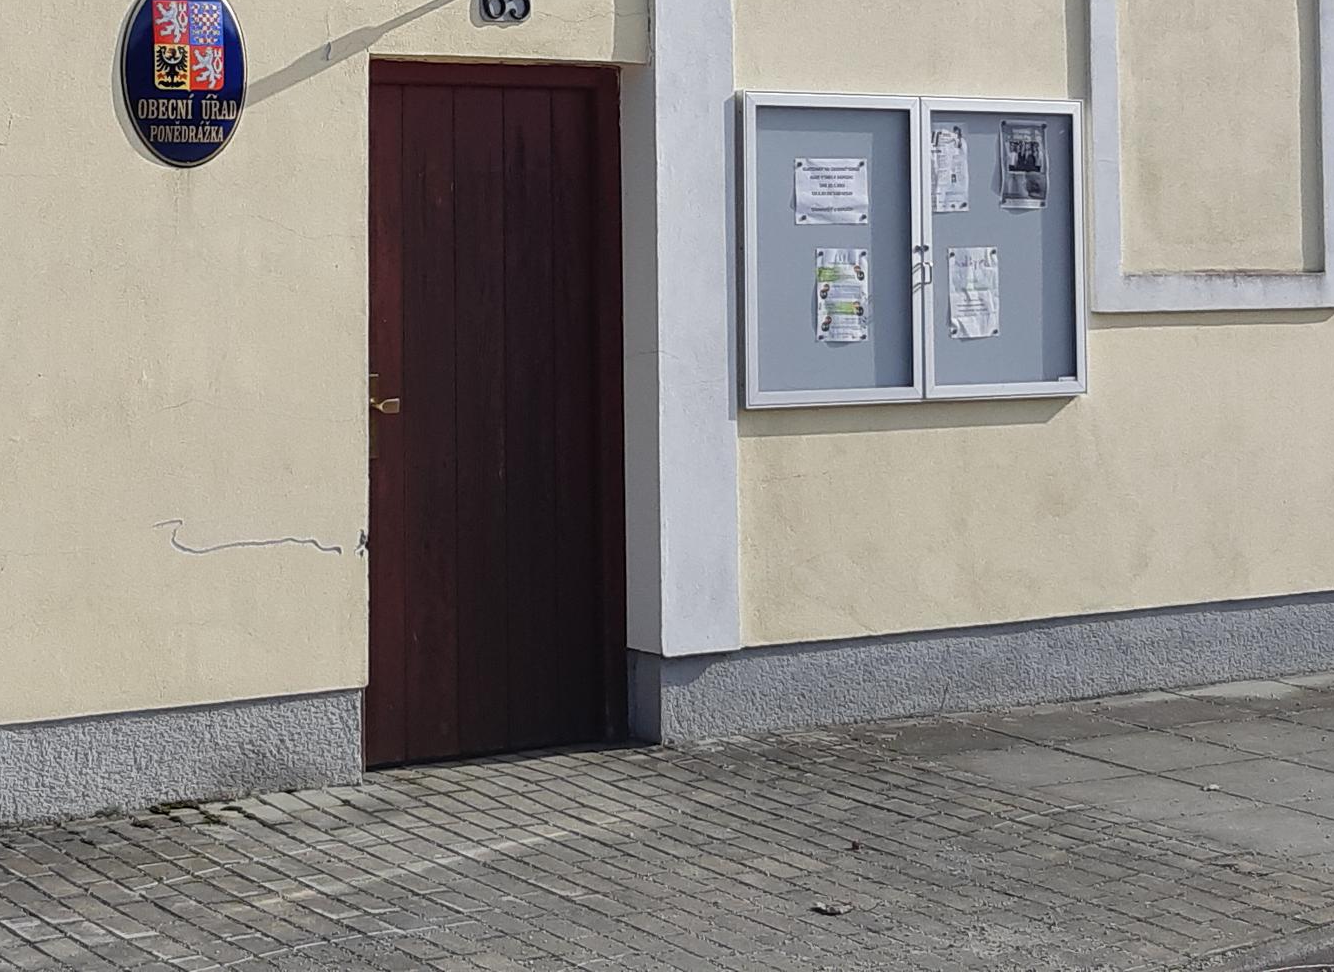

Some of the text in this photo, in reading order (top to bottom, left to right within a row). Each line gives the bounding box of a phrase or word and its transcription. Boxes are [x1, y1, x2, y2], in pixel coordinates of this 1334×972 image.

[138, 94, 237, 120] OBECNÍ ÚŘAD
[149, 121, 224, 143] PONĚDRÁŽKA
